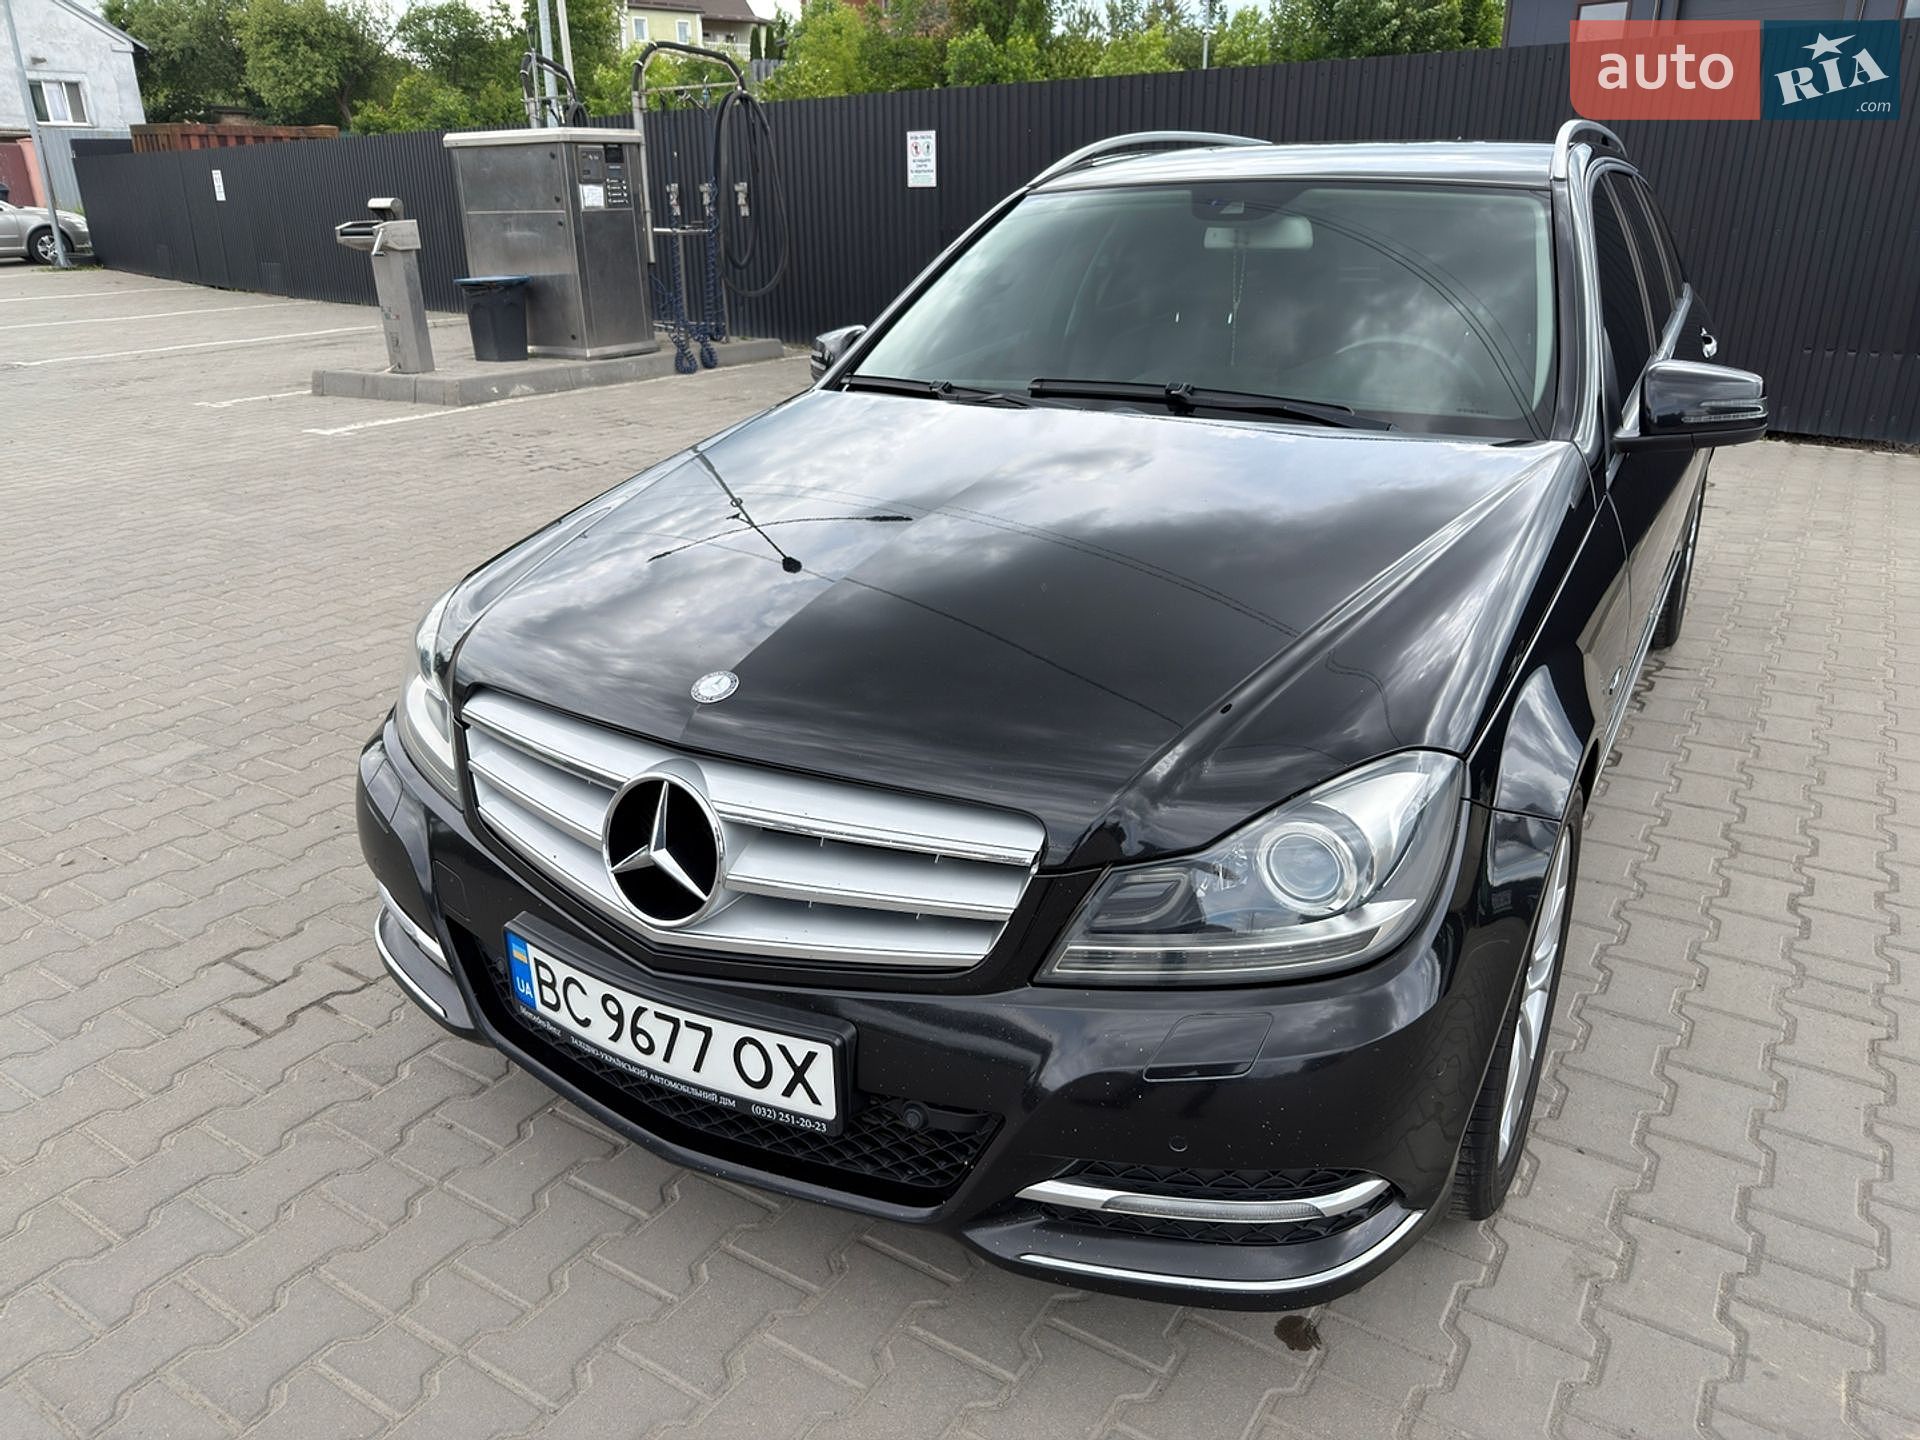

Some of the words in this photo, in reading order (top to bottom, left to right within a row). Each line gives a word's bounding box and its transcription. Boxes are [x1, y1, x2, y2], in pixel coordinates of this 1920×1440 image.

[516, 976, 533, 998] UA
[534, 956, 591, 1029] BC
[600, 993, 713, 1073] 9677
[733, 1036, 822, 1106] OX
[751, 1103, 776, 1120] (032)
[779, 1111, 827, 1133] 251-20-23
